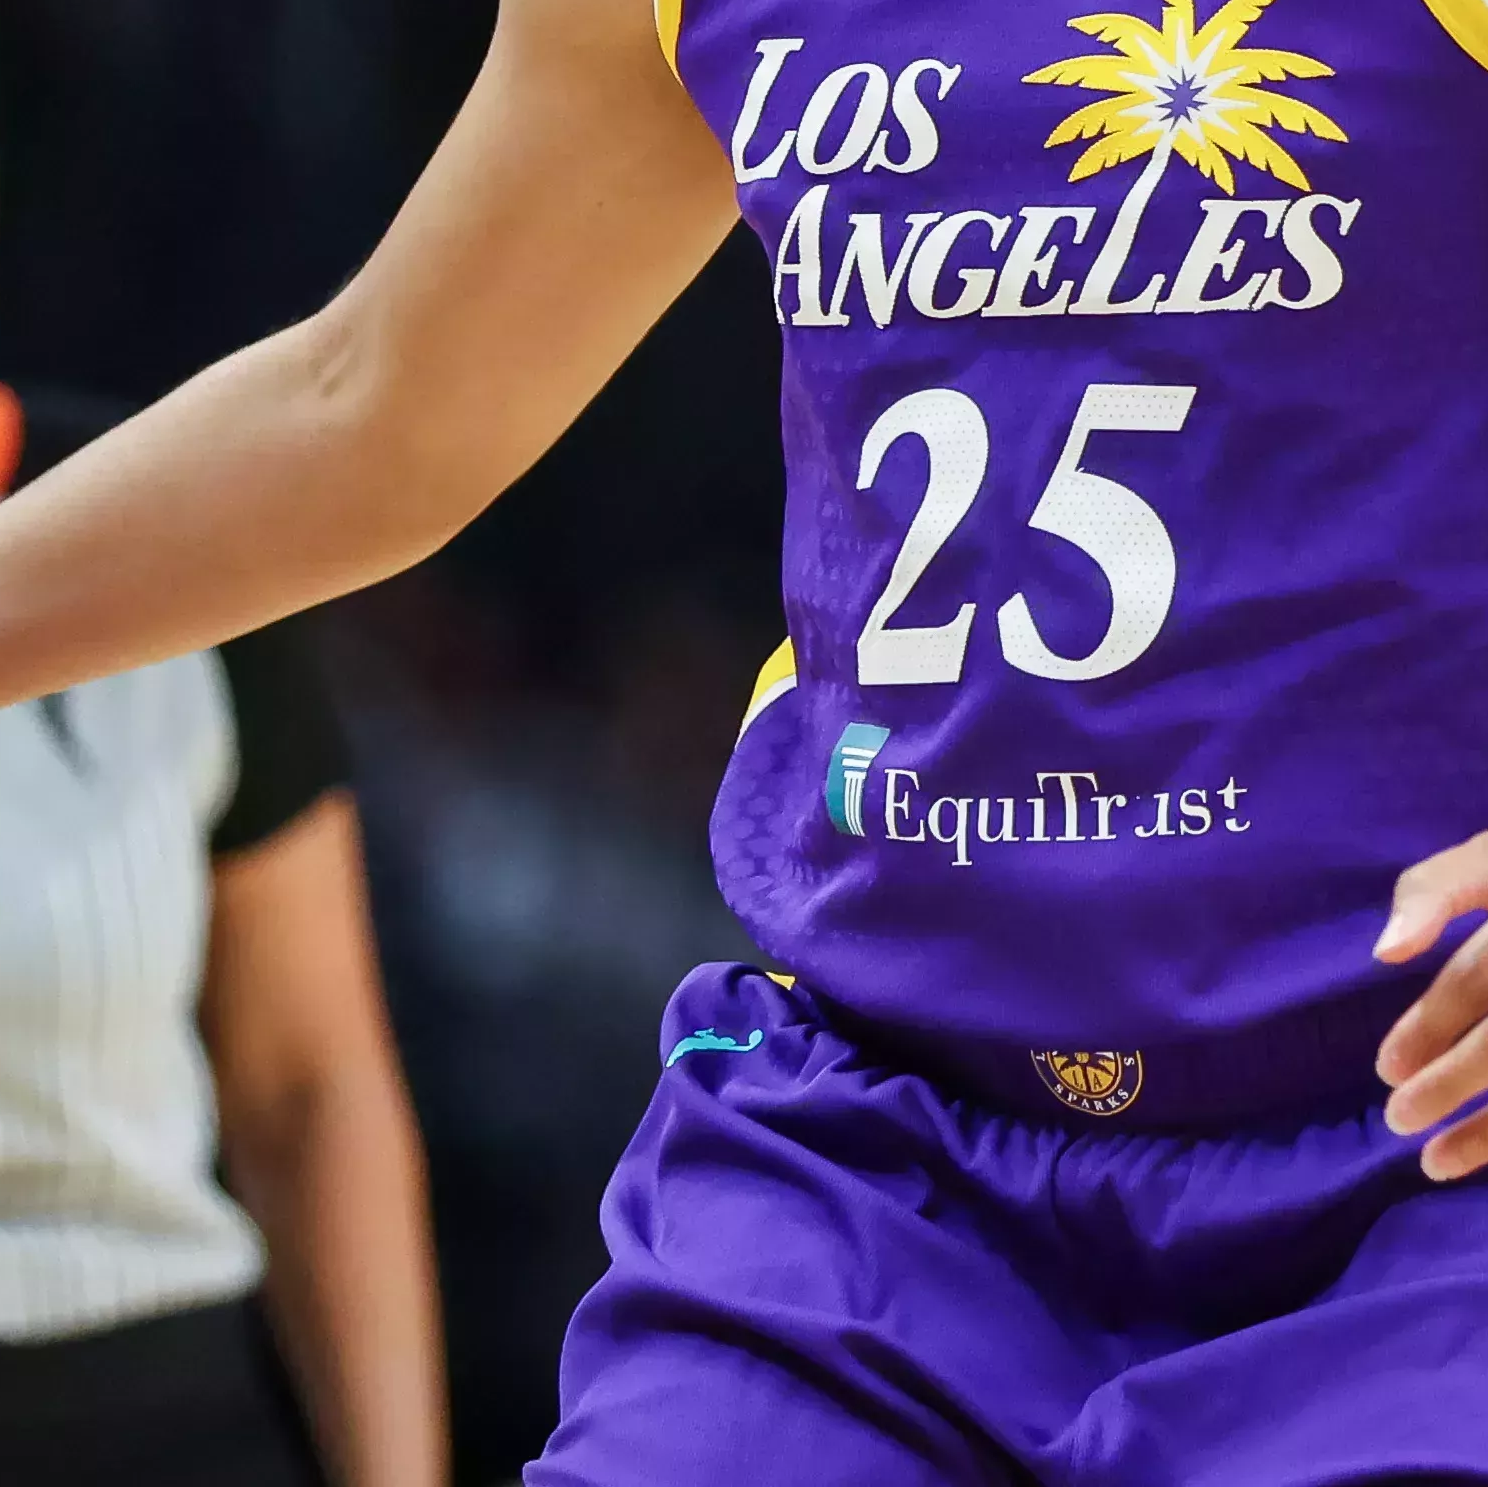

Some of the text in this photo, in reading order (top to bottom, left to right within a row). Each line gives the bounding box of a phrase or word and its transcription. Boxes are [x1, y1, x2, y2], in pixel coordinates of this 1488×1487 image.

[730, 37, 963, 184] LOS
[772, 167, 1363, 330] ANGELES
[855, 383, 1199, 686] 25
[884, 767, 1251, 866] EquiTrust
[1053, 1083, 1130, 1112] SPARKS
